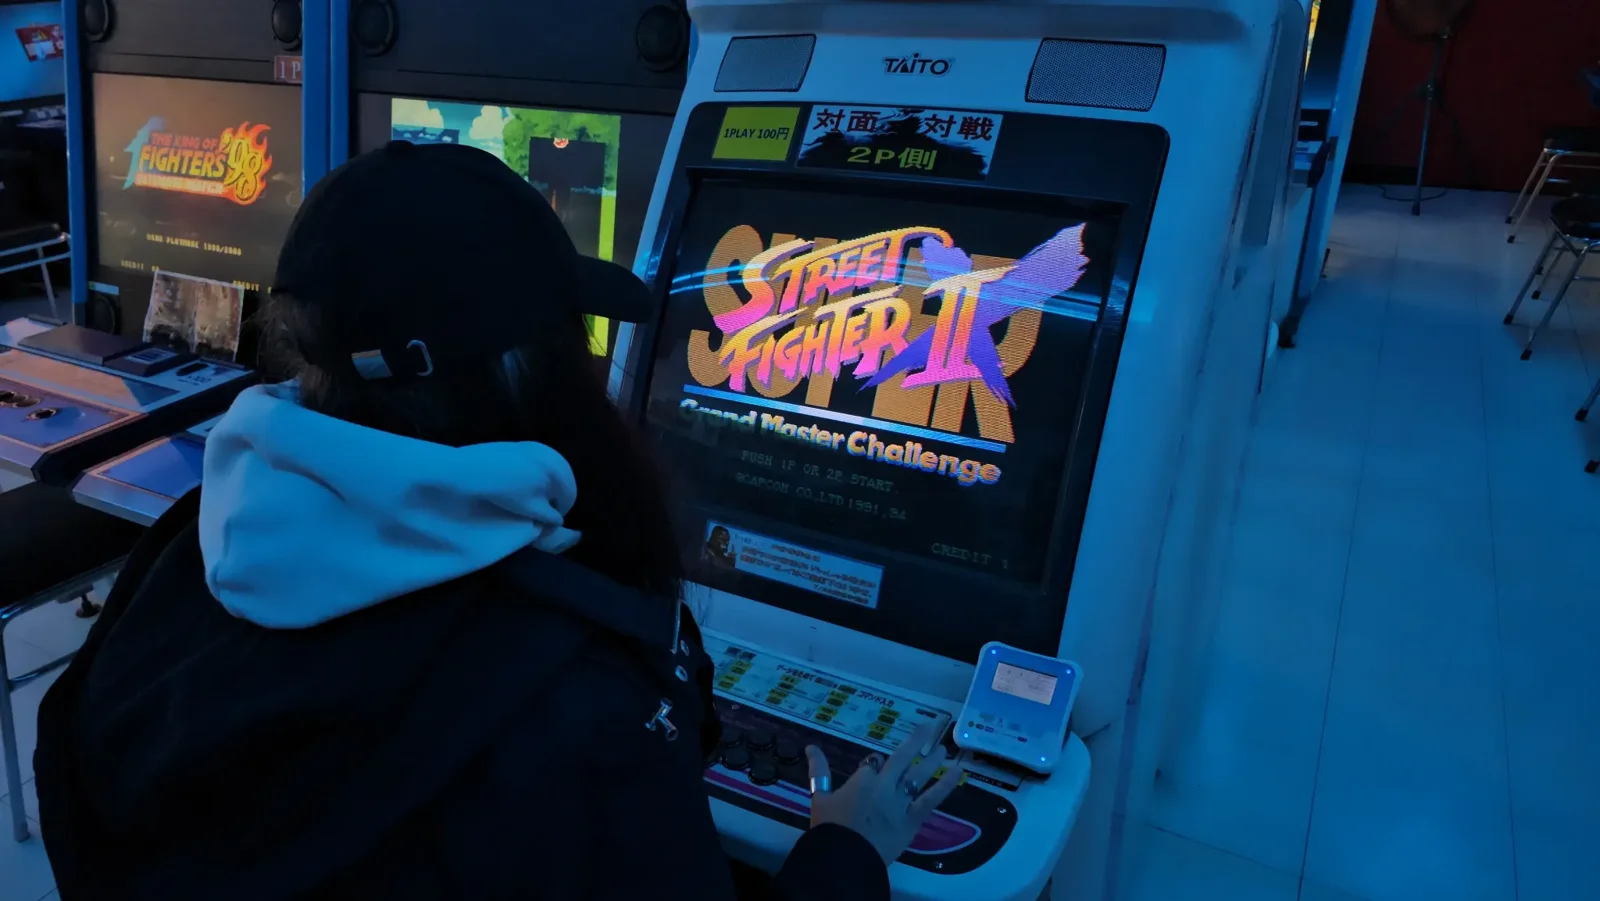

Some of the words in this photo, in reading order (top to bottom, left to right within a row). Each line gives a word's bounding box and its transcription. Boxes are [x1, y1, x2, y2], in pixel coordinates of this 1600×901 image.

[884, 52, 951, 75] TAITO
[724, 128, 756, 139] 1PLAY
[757, 127, 790, 141] 100円
[813, 108, 881, 134] 対面
[922, 113, 994, 141] 対戦
[202, 138, 218, 151] OF
[847, 146, 938, 170] 2P側
[139, 145, 227, 178] FIGHTERS
[713, 226, 955, 334] STREET
[719, 285, 912, 393] FIGHTER
[761, 412, 845, 450] Master
[847, 430, 1001, 486] Challenge
[740, 449, 773, 467] PUSH
[782, 459, 796, 471] 1P
[803, 465, 820, 477] OR
[826, 468, 844, 483] 2P
[931, 542, 993, 566] CREDIT
[1001, 559, 1009, 570] 1
